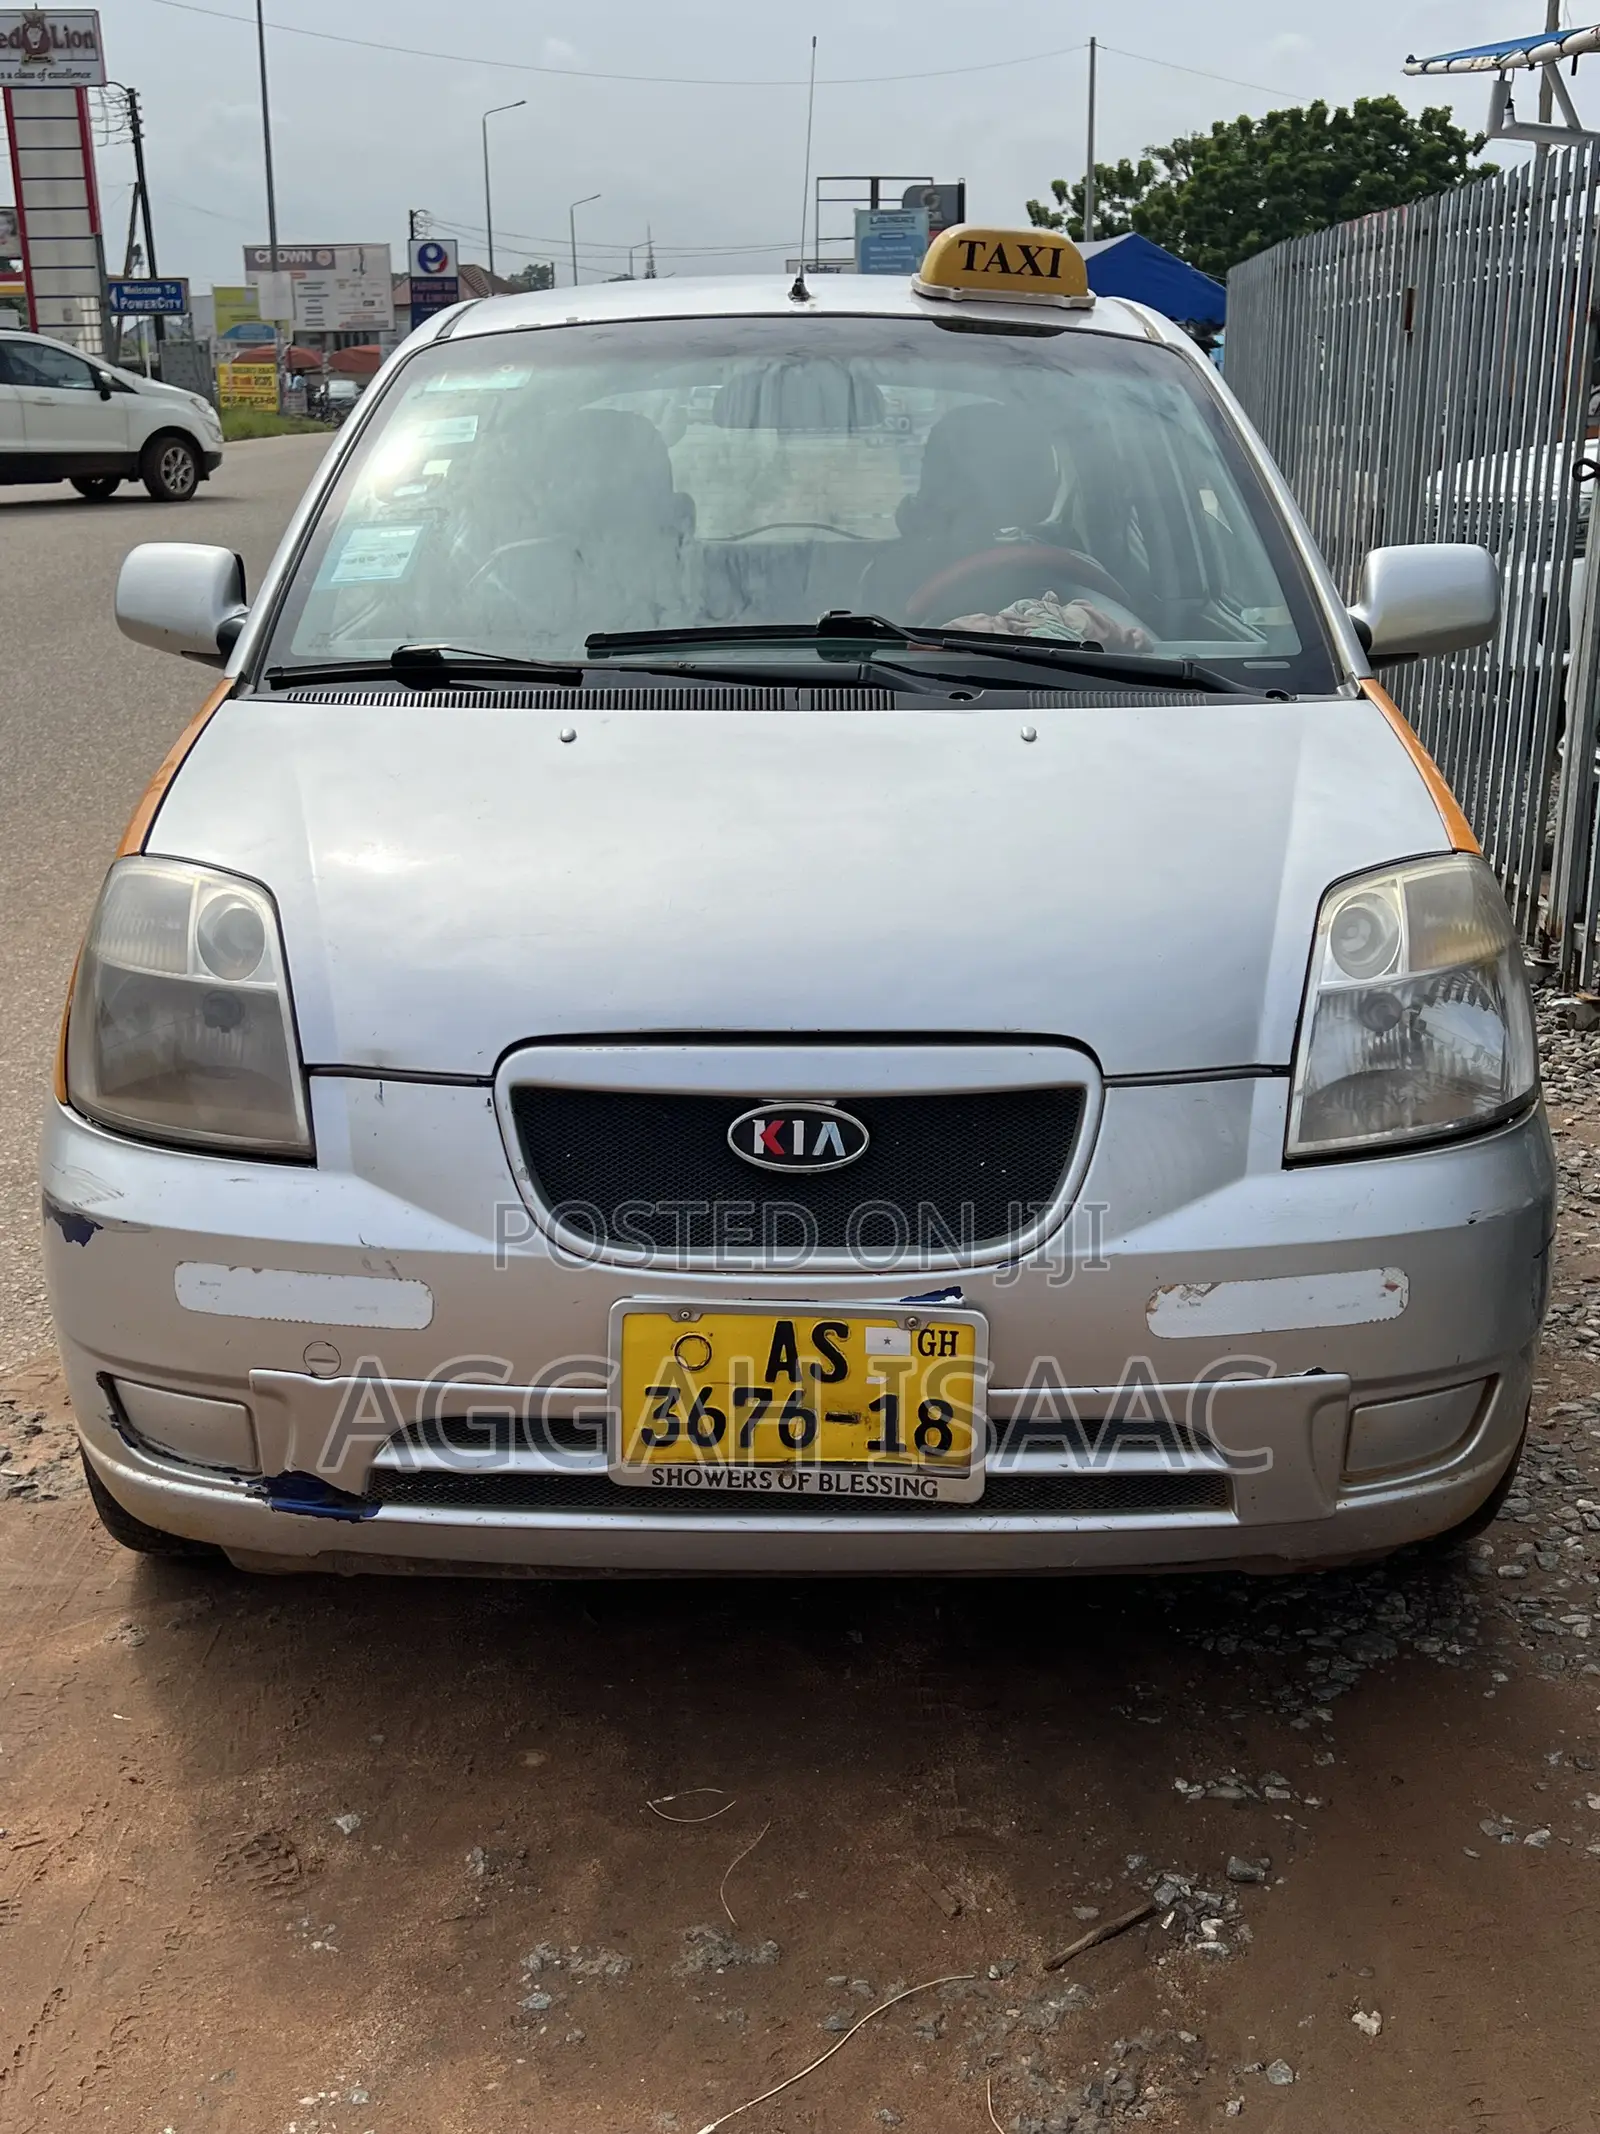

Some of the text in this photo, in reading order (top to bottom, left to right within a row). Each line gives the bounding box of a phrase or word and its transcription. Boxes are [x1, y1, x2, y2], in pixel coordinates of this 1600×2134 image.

[0, 25, 95, 49] ed Lion
[958, 239, 1065, 279] TAXI
[122, 284, 177, 295] Welcome To
[752, 1119, 846, 1156] KIA
[765, 1320, 960, 1384] AS GH
[640, 1386, 955, 1457] 3676-18
[651, 1467, 940, 1500] SHOWERS OF BLESSING
